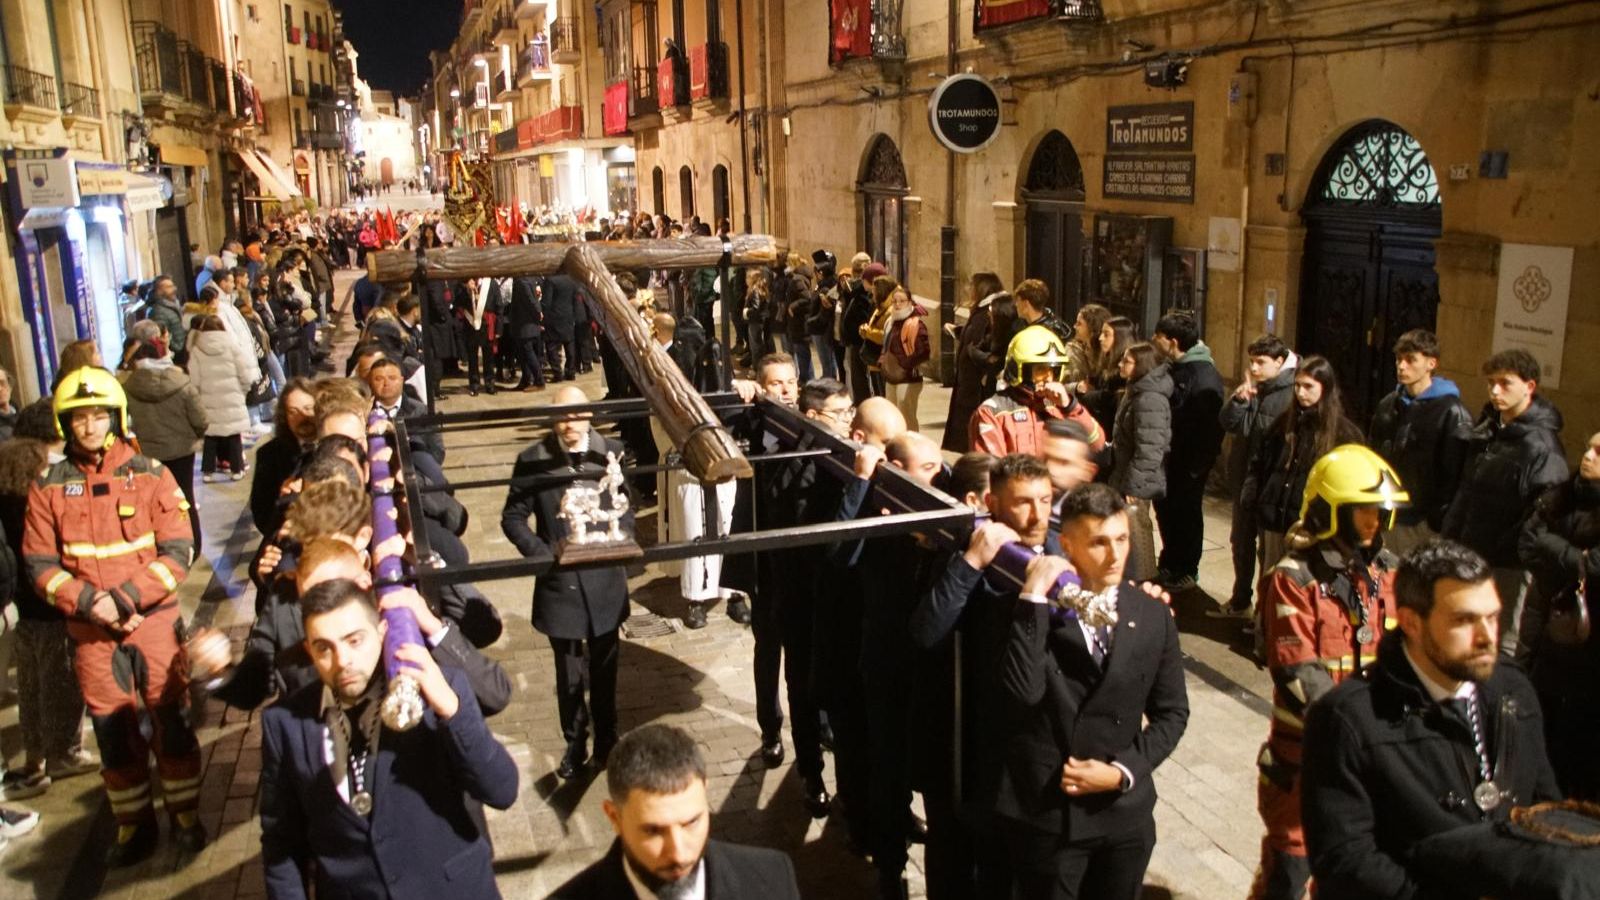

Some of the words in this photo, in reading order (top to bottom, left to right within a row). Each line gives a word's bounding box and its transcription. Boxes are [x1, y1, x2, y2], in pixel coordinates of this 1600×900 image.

[938, 109, 998, 118] TROTAMUNDOS
[959, 123, 979, 133] Shop
[65, 484, 83, 496] 220
